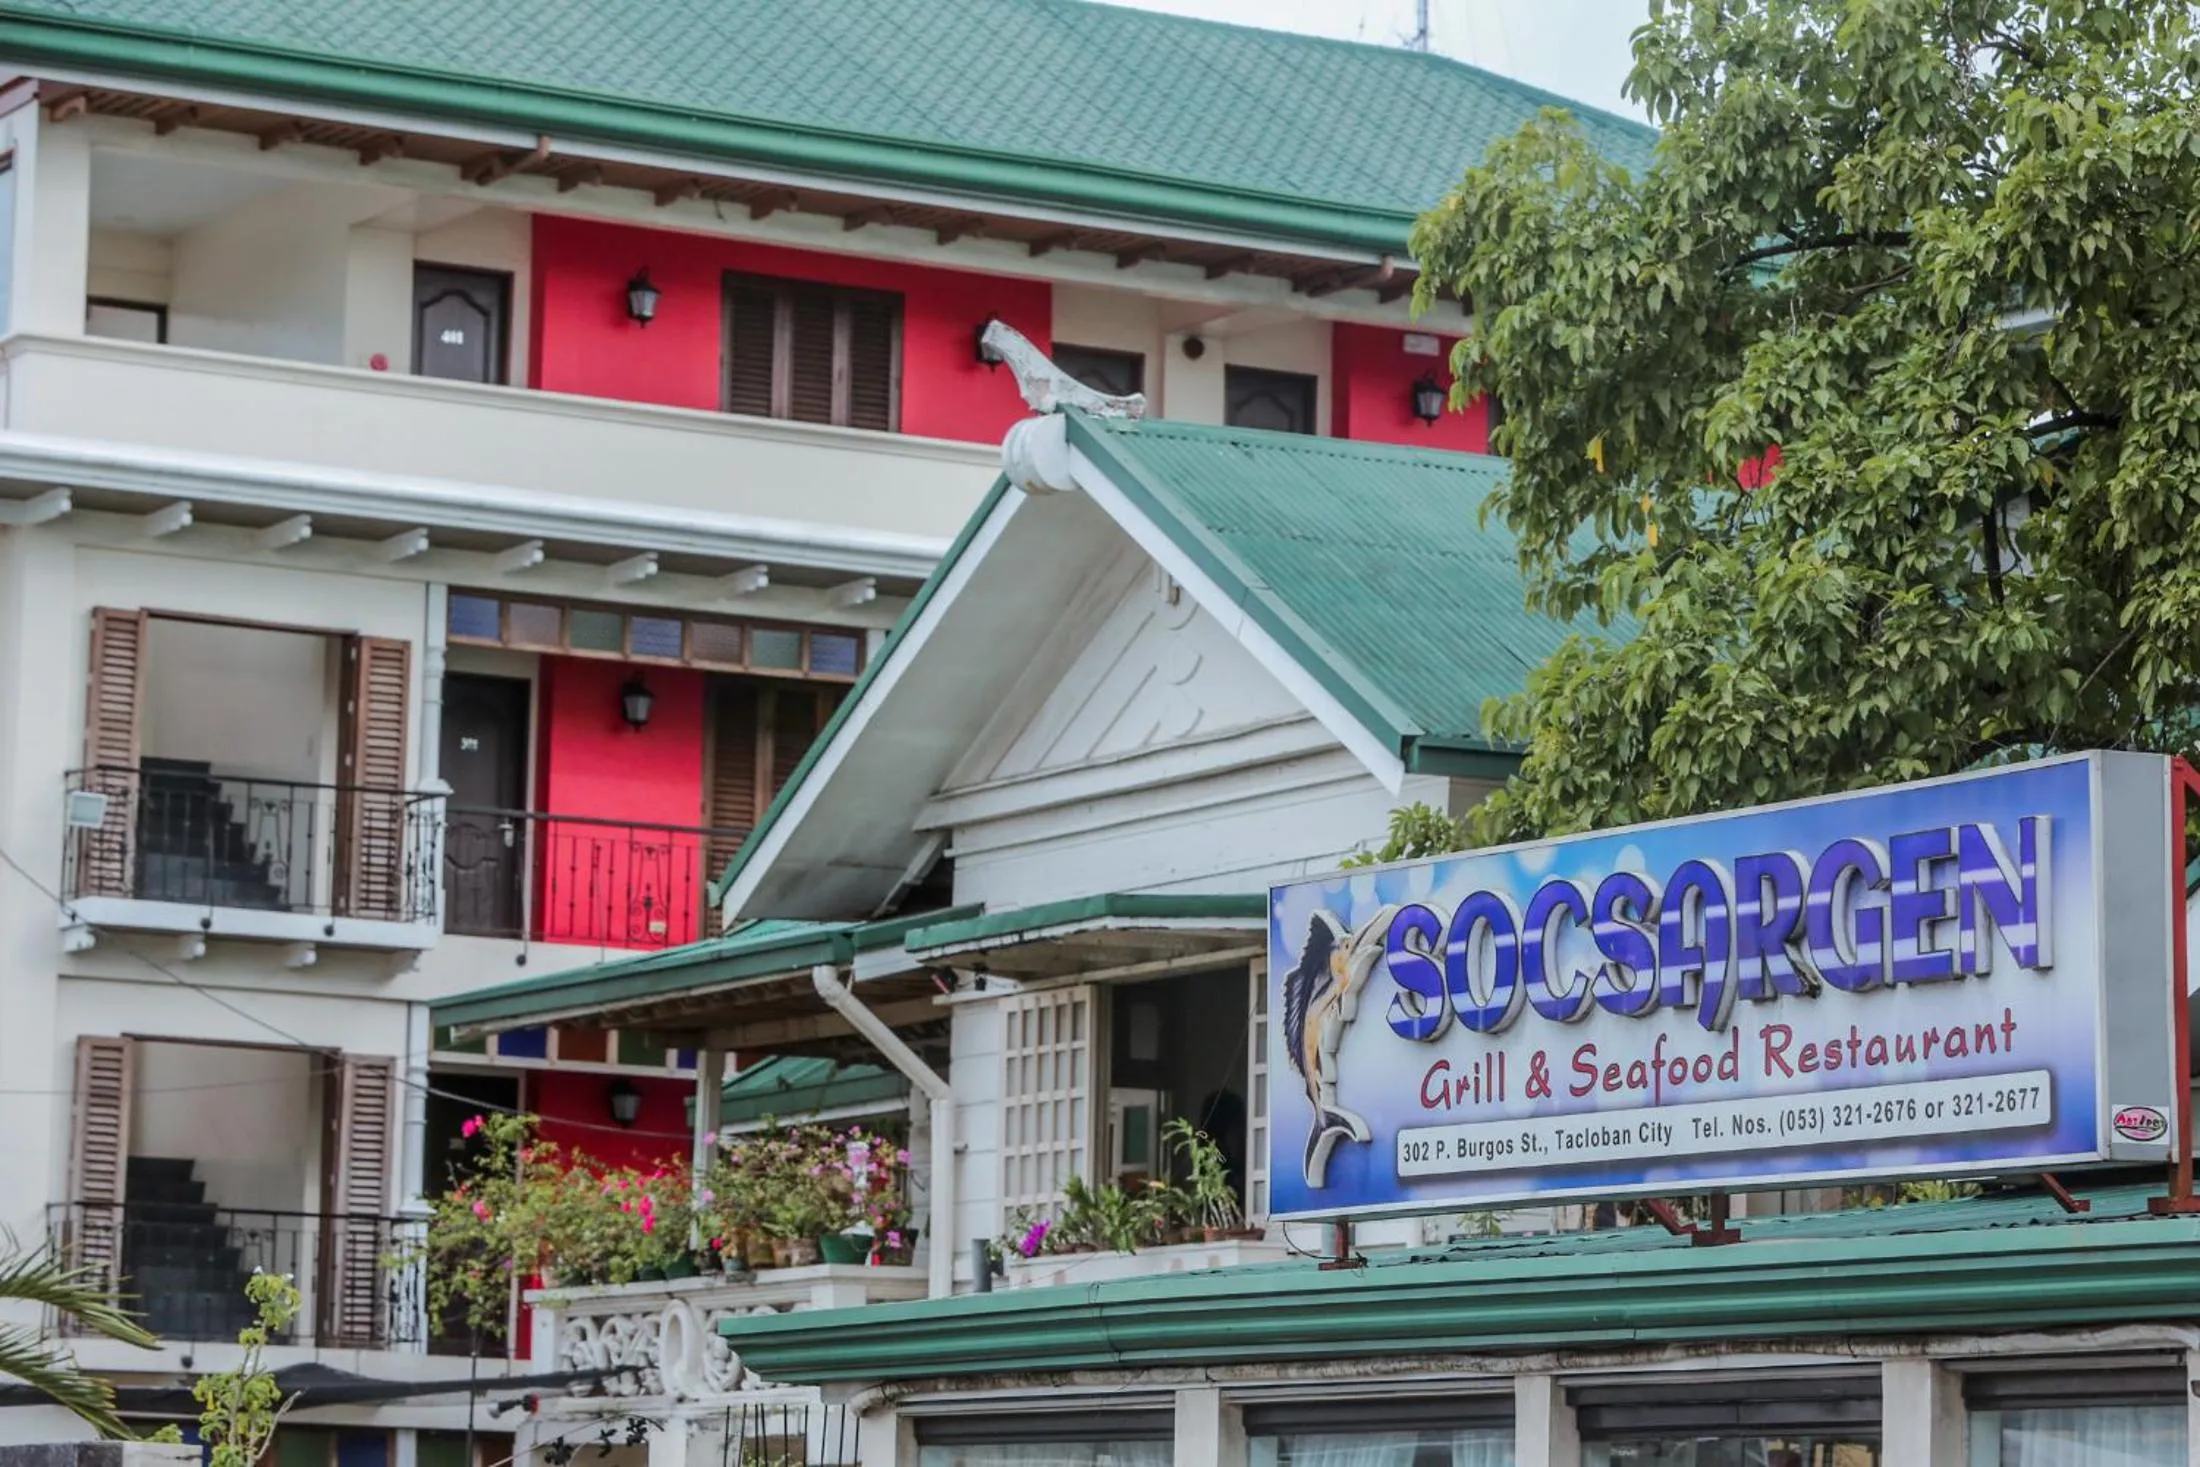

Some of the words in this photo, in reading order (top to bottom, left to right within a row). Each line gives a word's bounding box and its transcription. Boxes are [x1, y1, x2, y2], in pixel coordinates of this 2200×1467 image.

[1386, 815, 2053, 1043] SOCSARGEN
[1420, 1052, 1504, 1110] Grill
[1525, 1050, 1551, 1098] &
[1569, 1026, 1739, 1105] Seafood
[1760, 1007, 2017, 1078] Restaurant
[1403, 1141, 1429, 1163] 302
[1436, 1140, 1450, 1159] P.
[1458, 1137, 1513, 1160] Burgos
[1521, 1132, 1548, 1154] St.,
[1555, 1123, 1631, 1150] Tacloban
[1639, 1121, 1672, 1146] City
[1692, 1117, 1723, 1139] Tel.
[1733, 1114, 1771, 1135] Nos.
[1780, 1106, 1824, 1135] (053)
[1832, 1099, 1916, 1128] 321-2676
[1925, 1101, 1944, 1119] or
[1953, 1087, 2040, 1117] 321-2677
